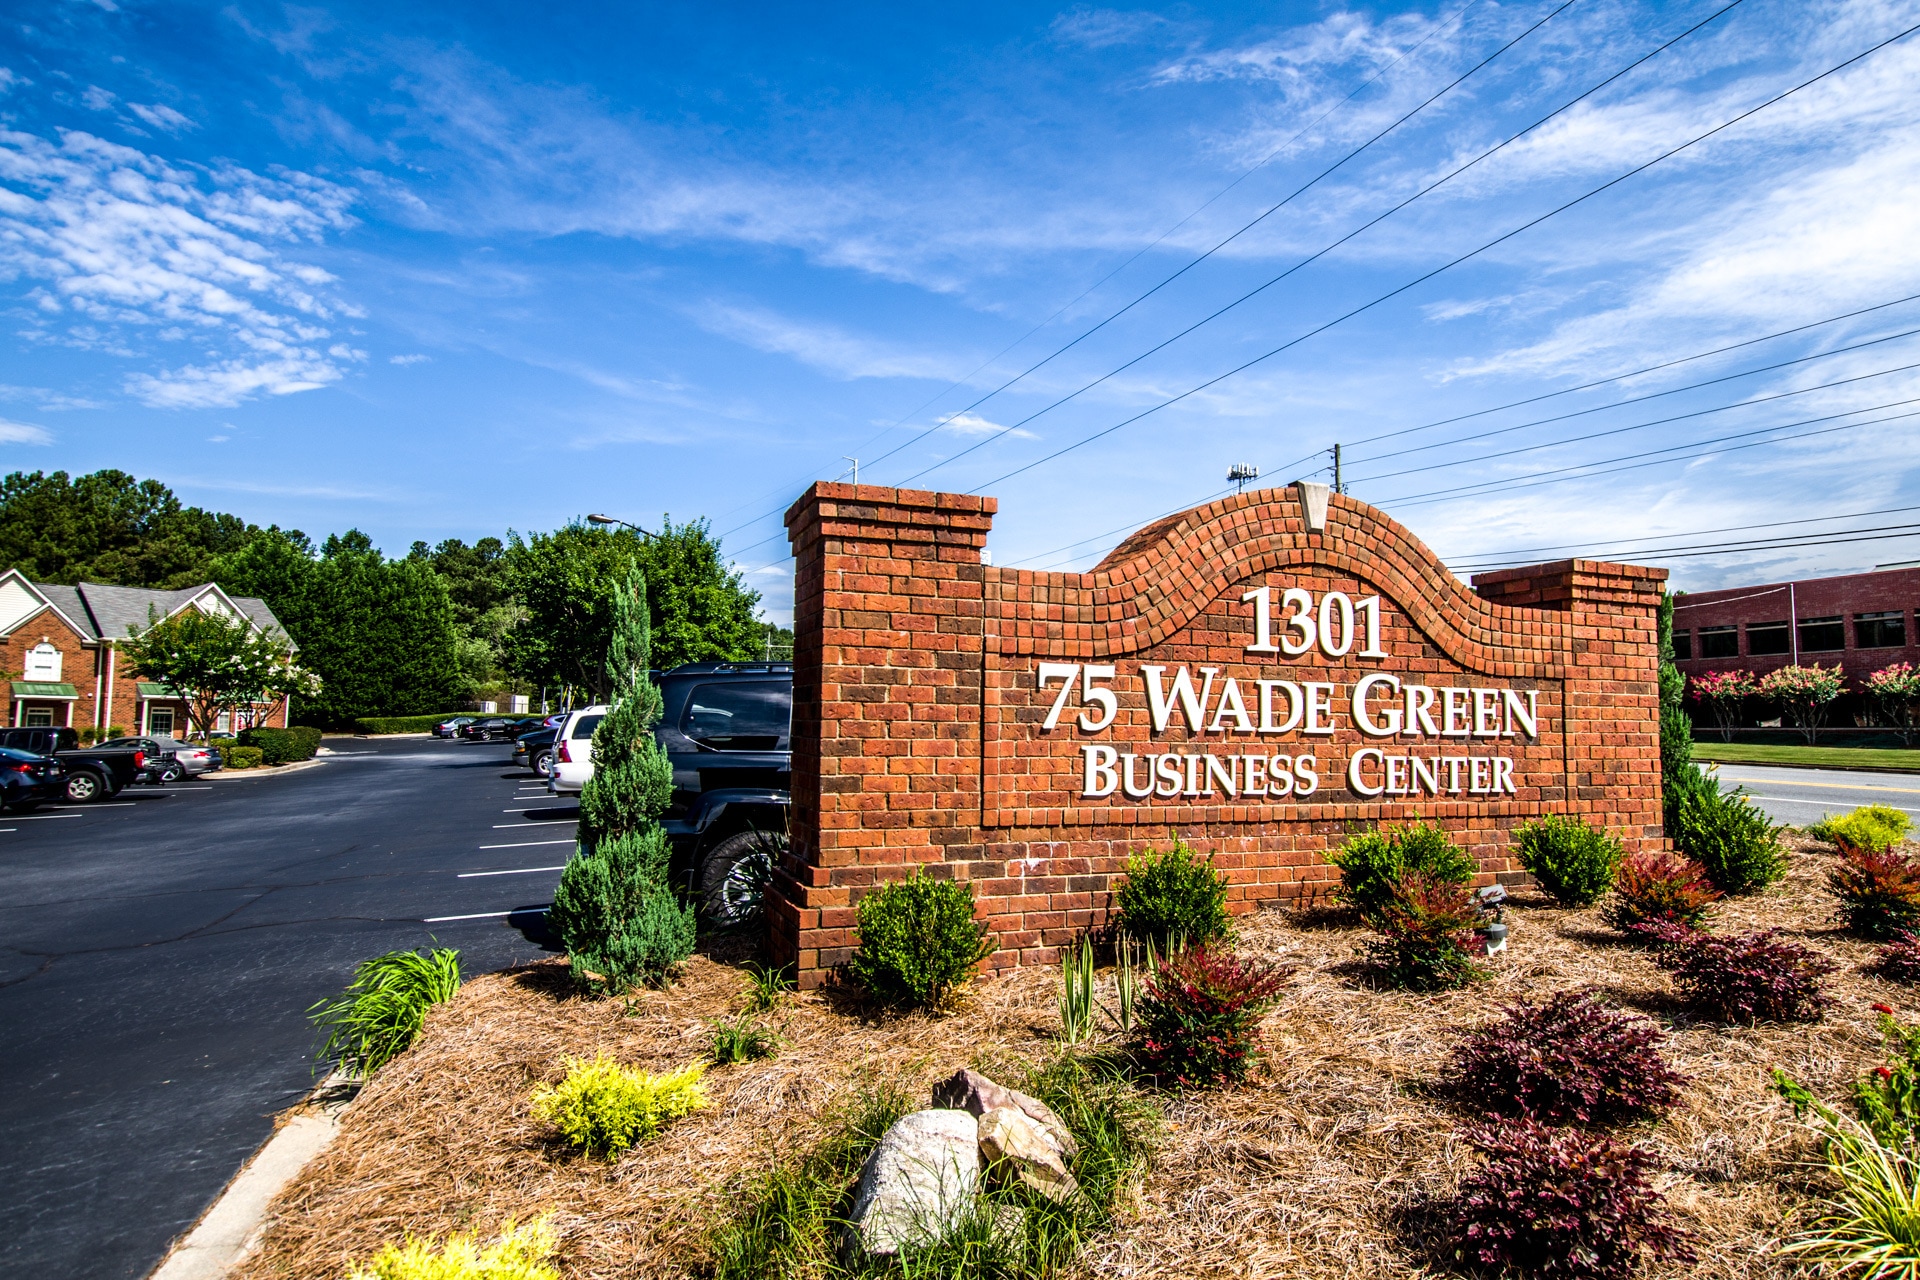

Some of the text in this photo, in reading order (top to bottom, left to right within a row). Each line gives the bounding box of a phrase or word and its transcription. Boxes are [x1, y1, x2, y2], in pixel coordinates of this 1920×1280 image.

[1243, 586, 1388, 657] 1301
[1038, 662, 1540, 738] 75 WADE GREEN
[1082, 745, 1517, 797] BUSINESS CENTER
